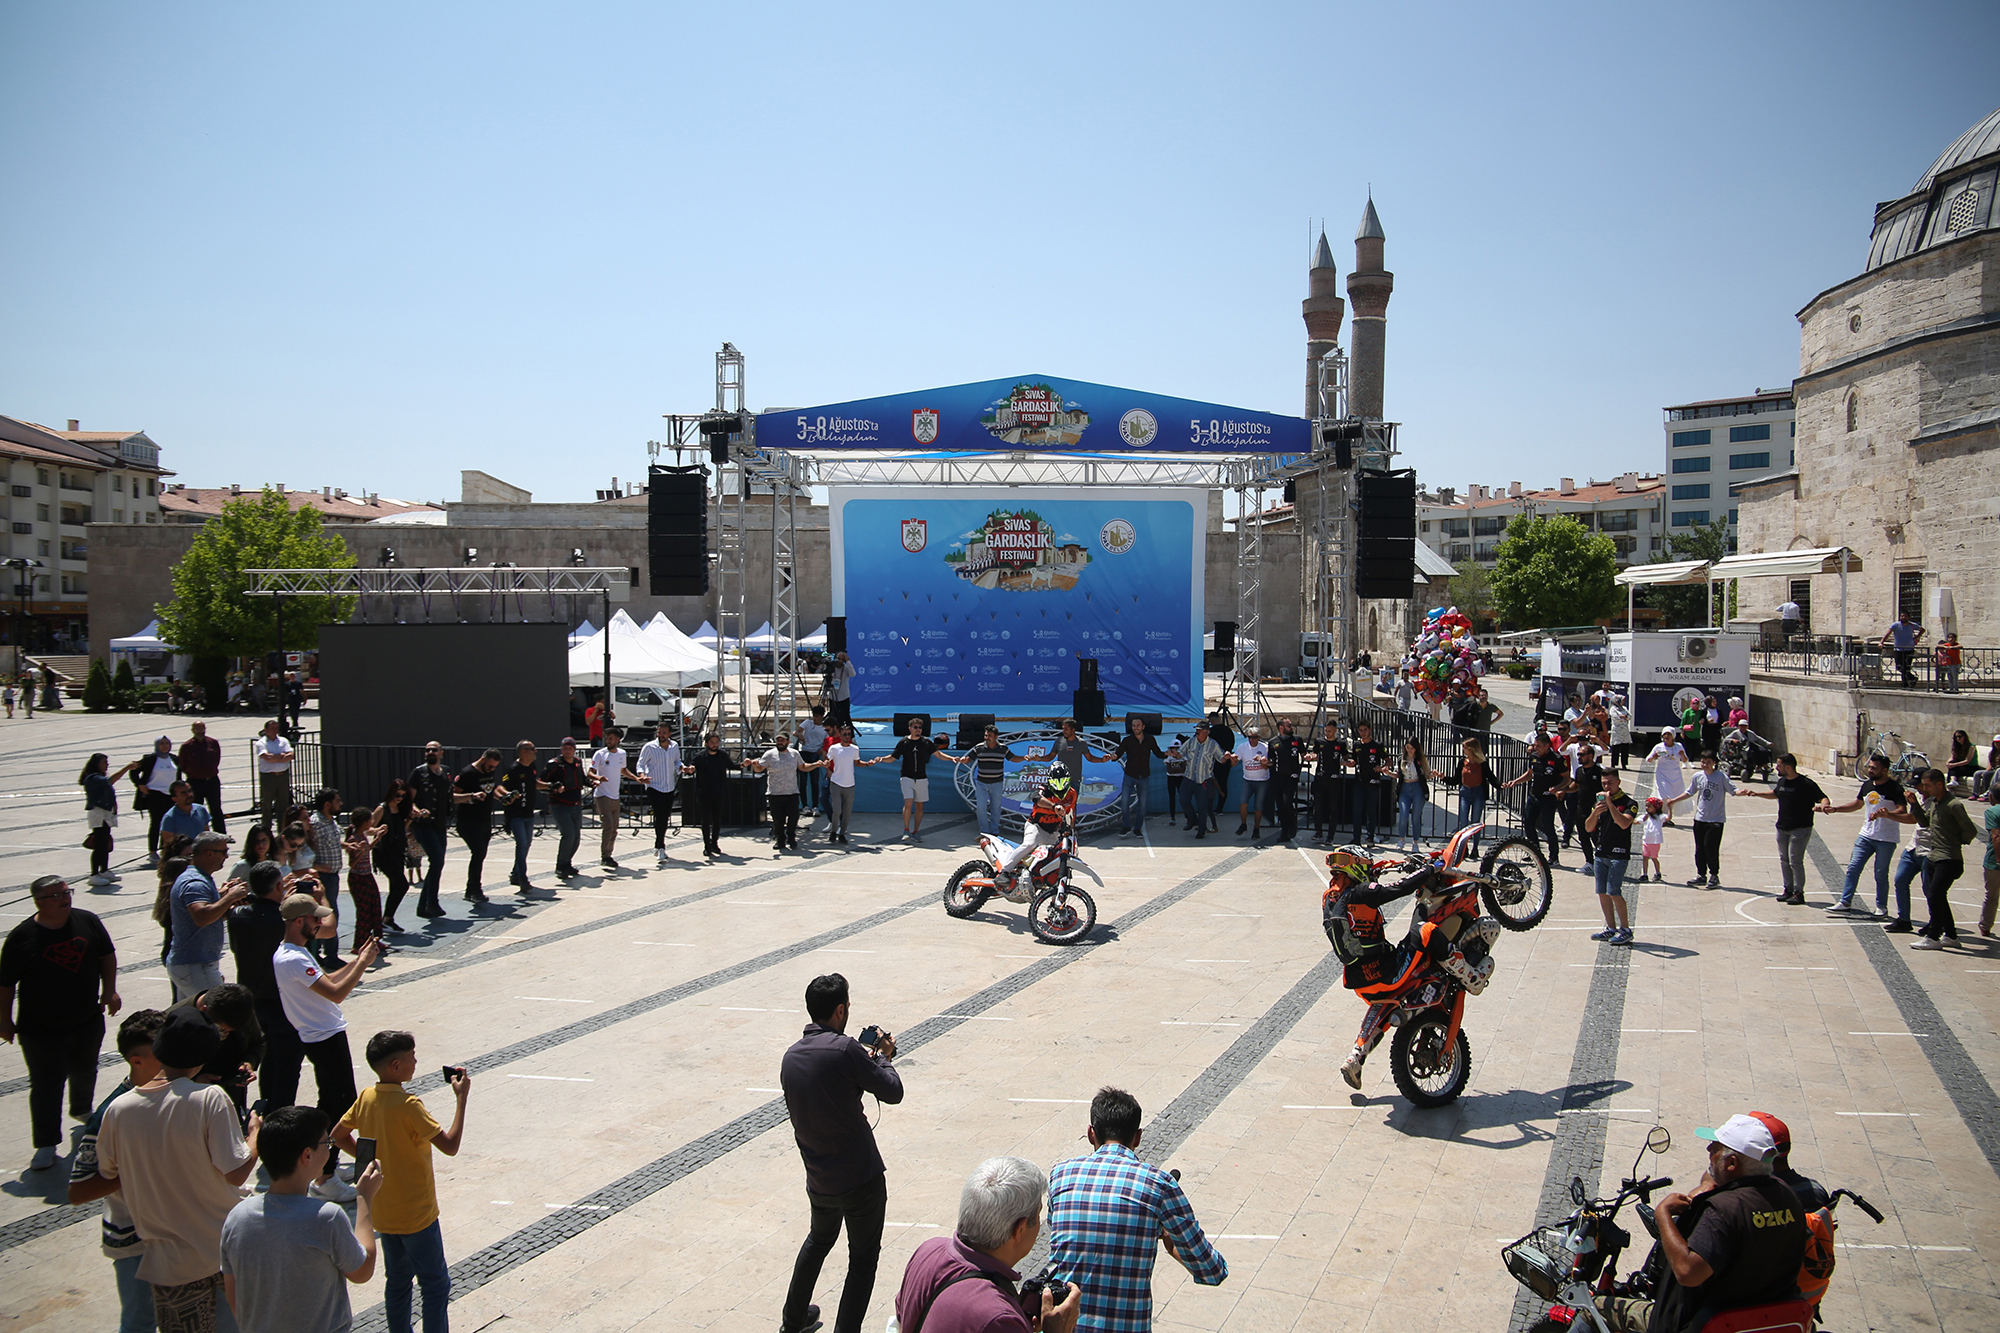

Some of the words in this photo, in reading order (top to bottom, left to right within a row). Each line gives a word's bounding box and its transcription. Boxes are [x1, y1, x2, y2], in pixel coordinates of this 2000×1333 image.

[1010, 401, 1060, 413] GARDAŞLIK
[796, 416, 826, 440] 5-8
[829, 416, 878, 433] Ağustos'ta
[1190, 420, 1220, 443] 5-8
[1222, 420, 1271, 436] Ağustos'ta
[985, 534, 1050, 549] GARDAŞLIK
[1752, 1208, 1795, 1228] ÖZKA
